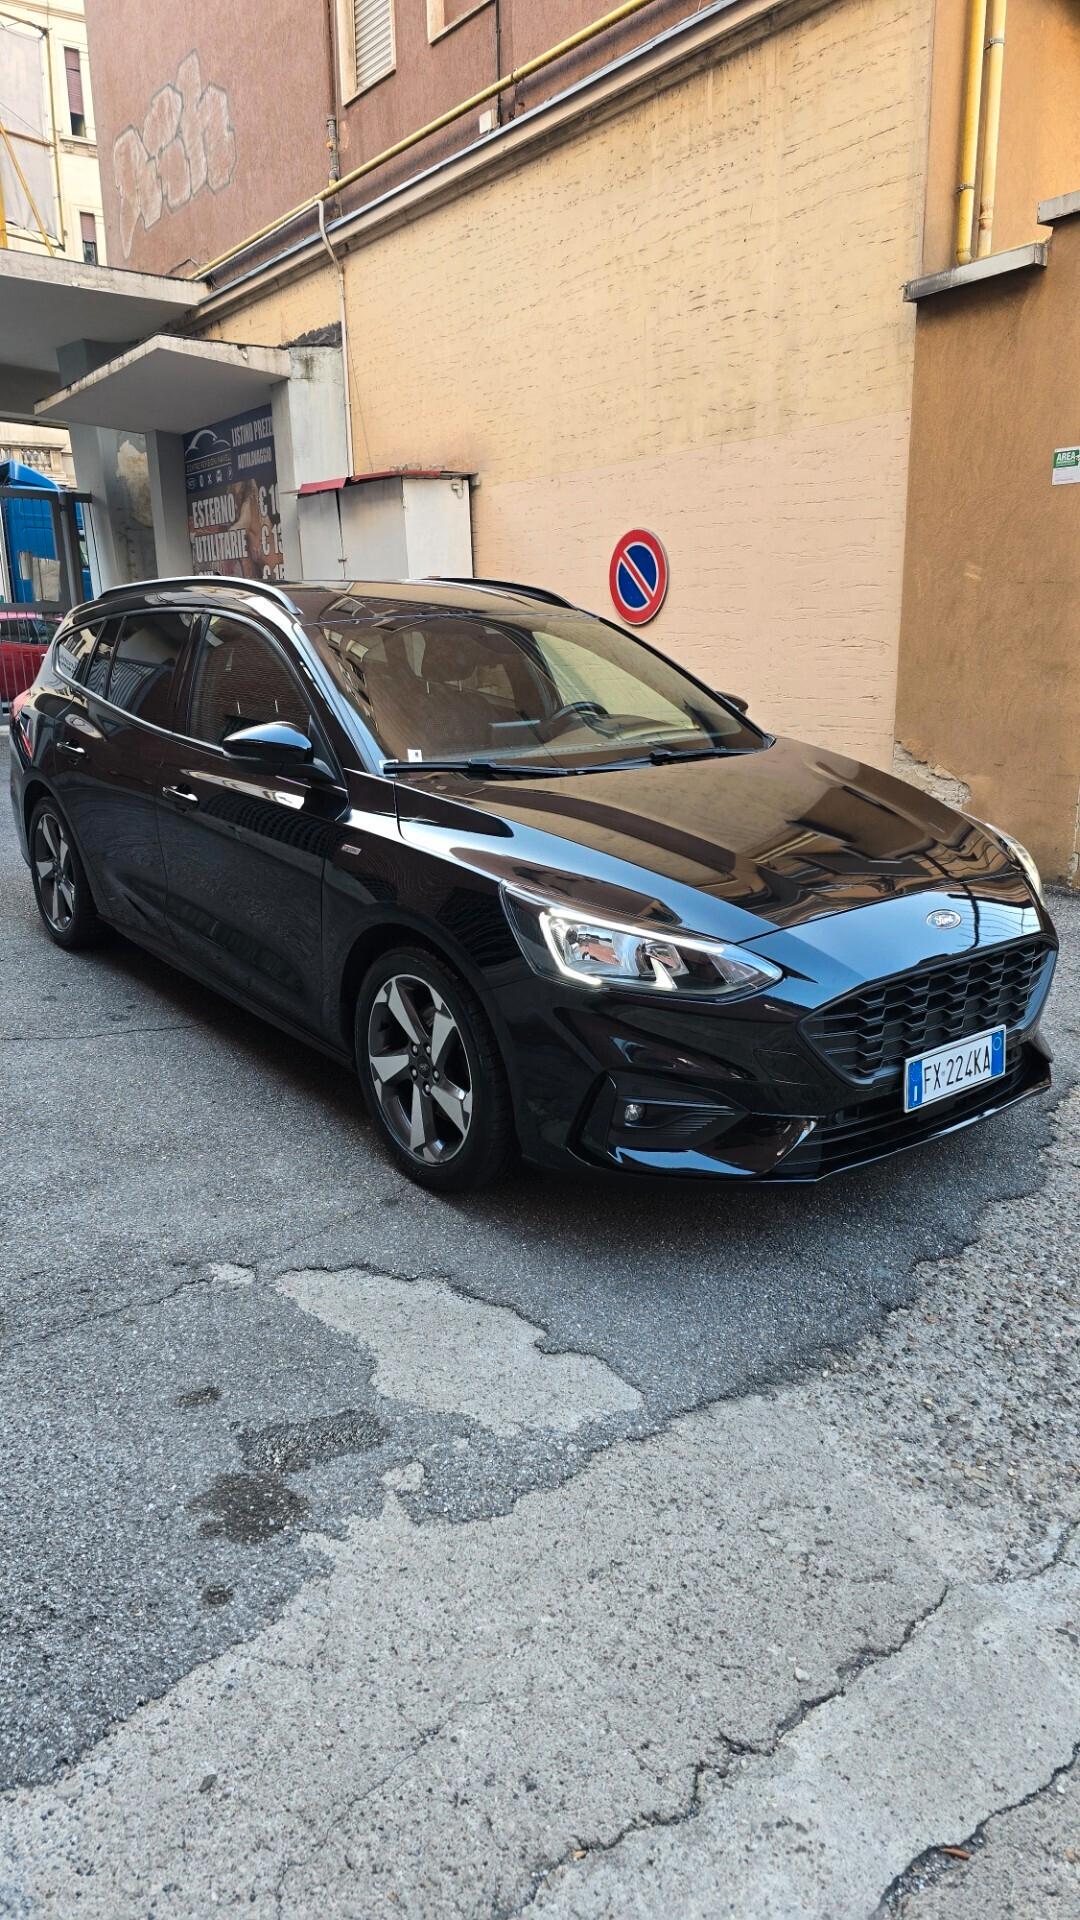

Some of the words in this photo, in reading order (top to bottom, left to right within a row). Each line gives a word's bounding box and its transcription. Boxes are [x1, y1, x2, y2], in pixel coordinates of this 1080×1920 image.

[232, 423, 253, 447] LISTINO
[254, 417, 273, 440] PREZZ
[1057, 452, 1076, 463] AREA
[192, 493, 236, 529] ESTERNO
[195, 530, 248, 562] UTILITARIE
